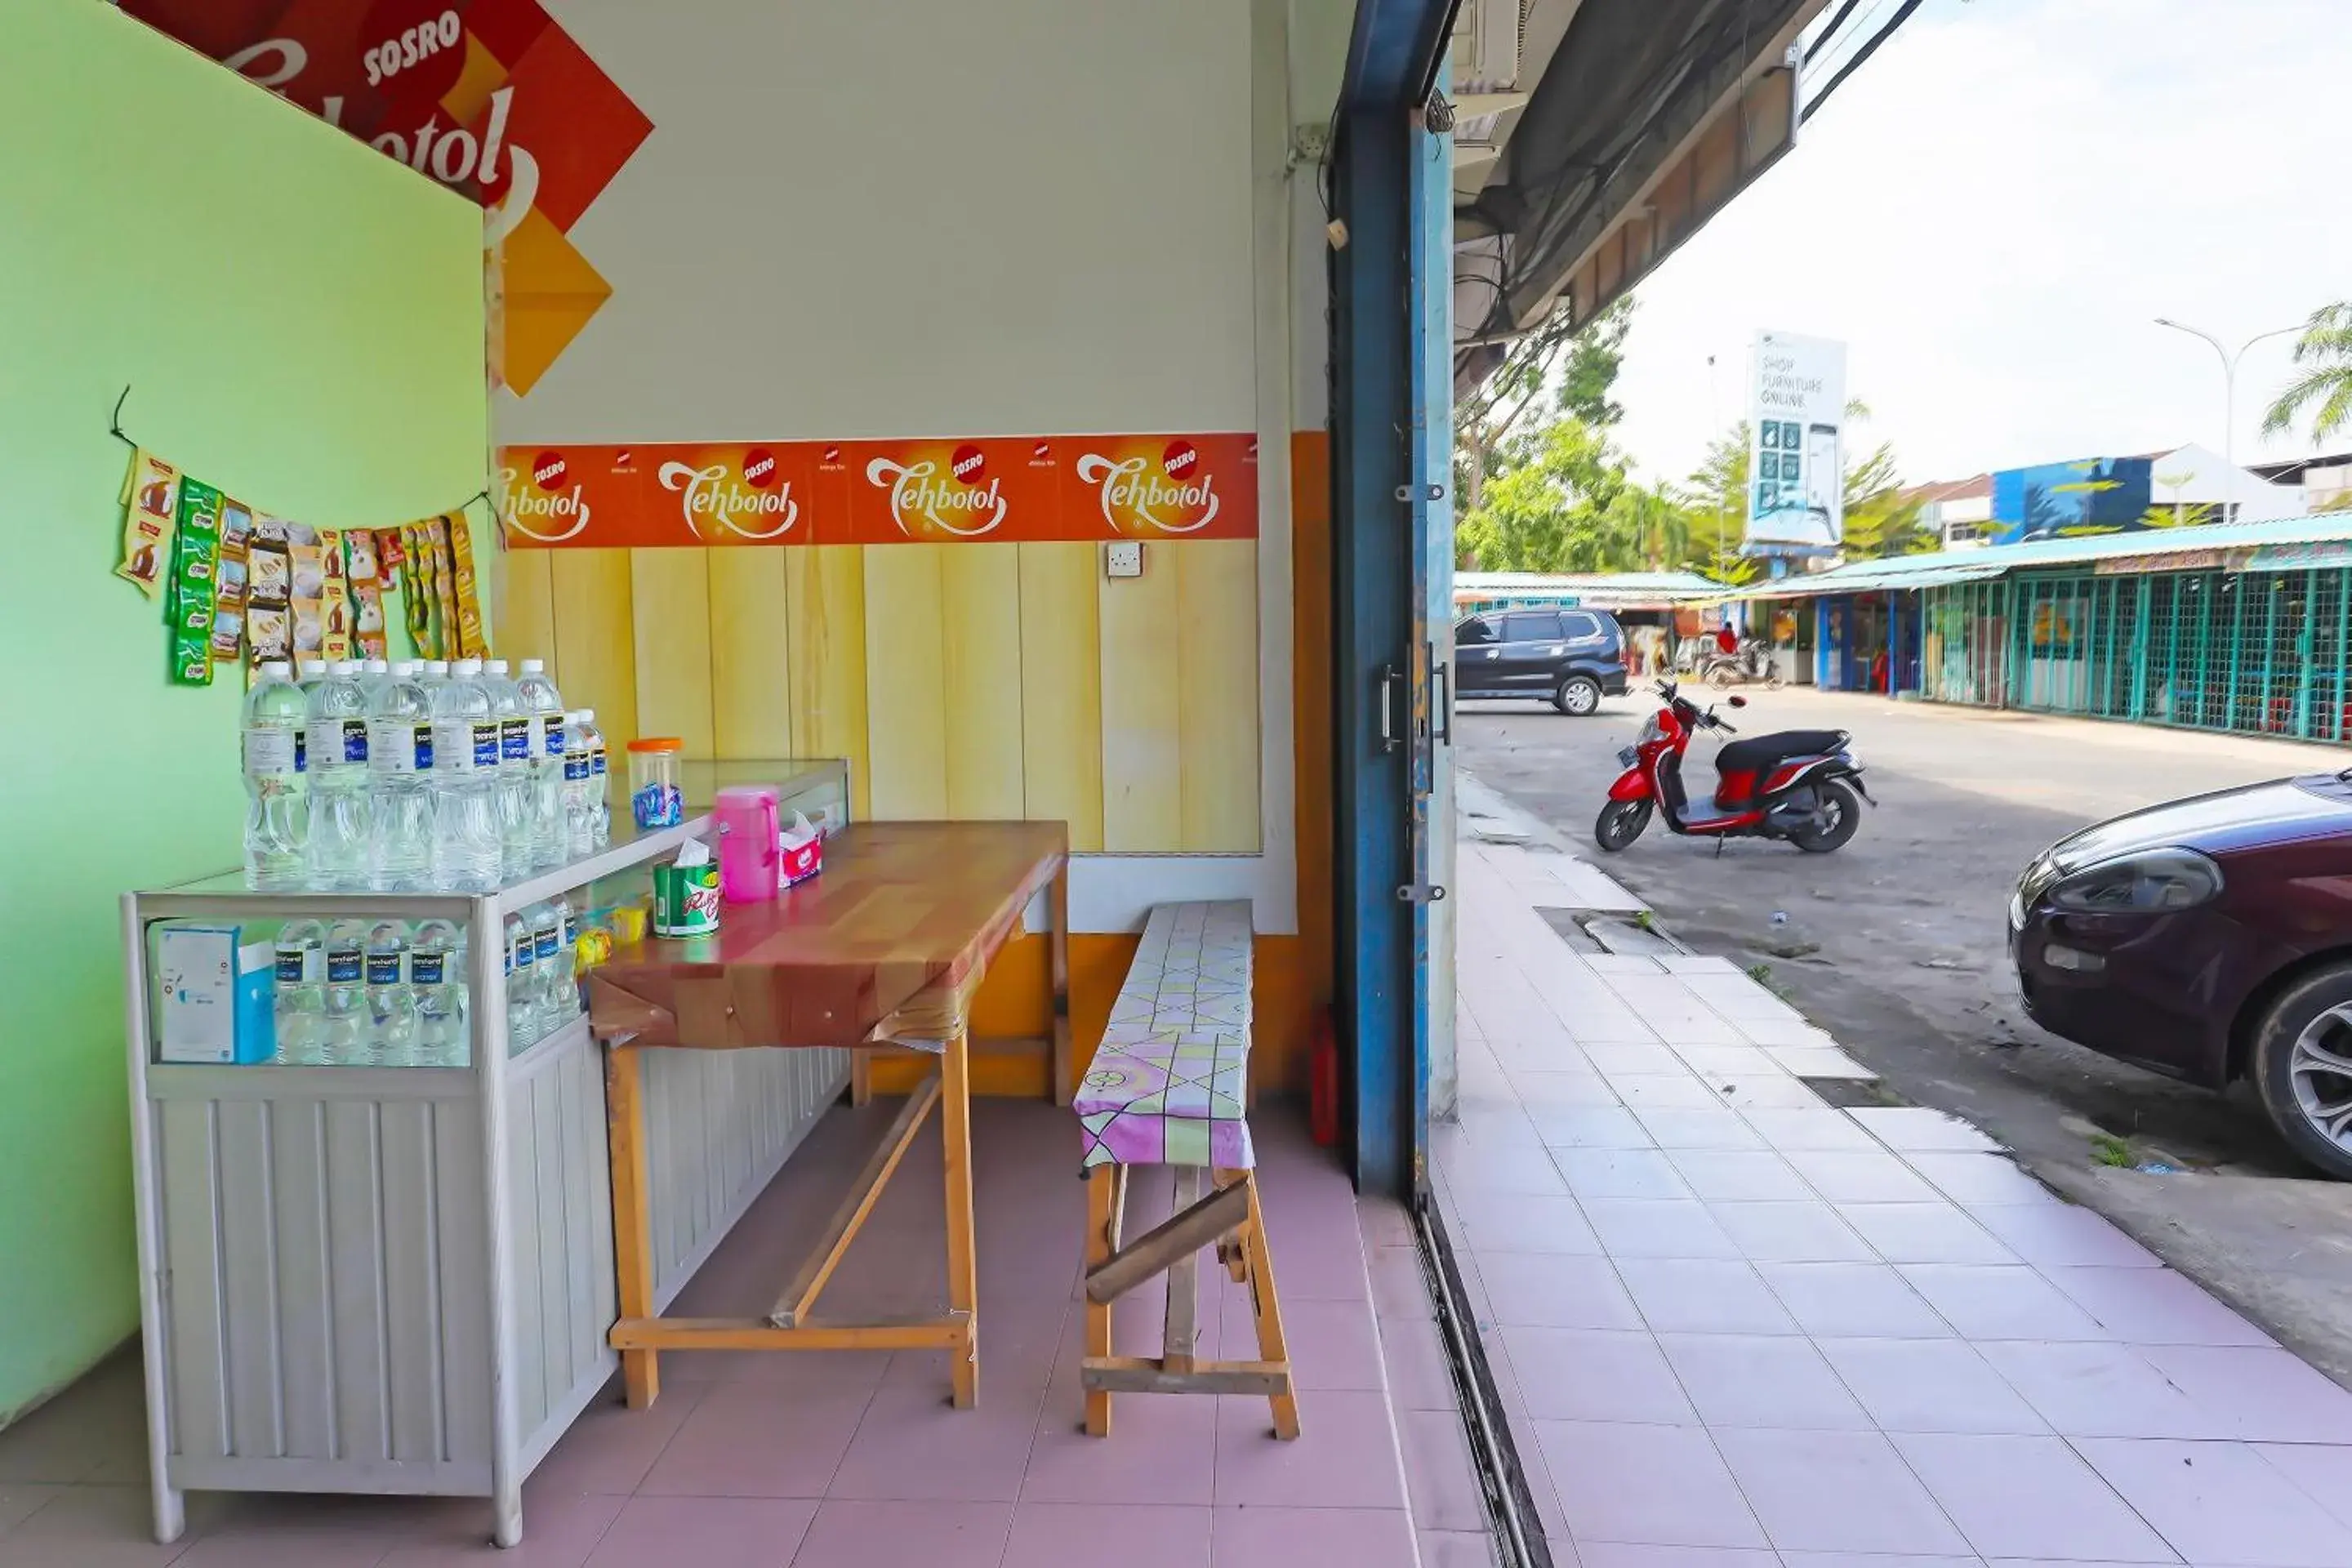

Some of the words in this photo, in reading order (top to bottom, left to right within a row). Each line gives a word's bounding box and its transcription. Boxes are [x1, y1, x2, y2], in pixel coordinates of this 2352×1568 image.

[363, 10, 461, 87] SOSRO
[534, 460, 565, 483] SOSRO
[743, 457, 775, 481] SOSRO
[952, 452, 983, 477] SOSRO
[1163, 448, 1196, 474] SOSRO
[657, 460, 798, 541] Tehbotol
[866, 457, 1008, 537] Tehbotol
[1076, 452, 1219, 534] Tehbotol
